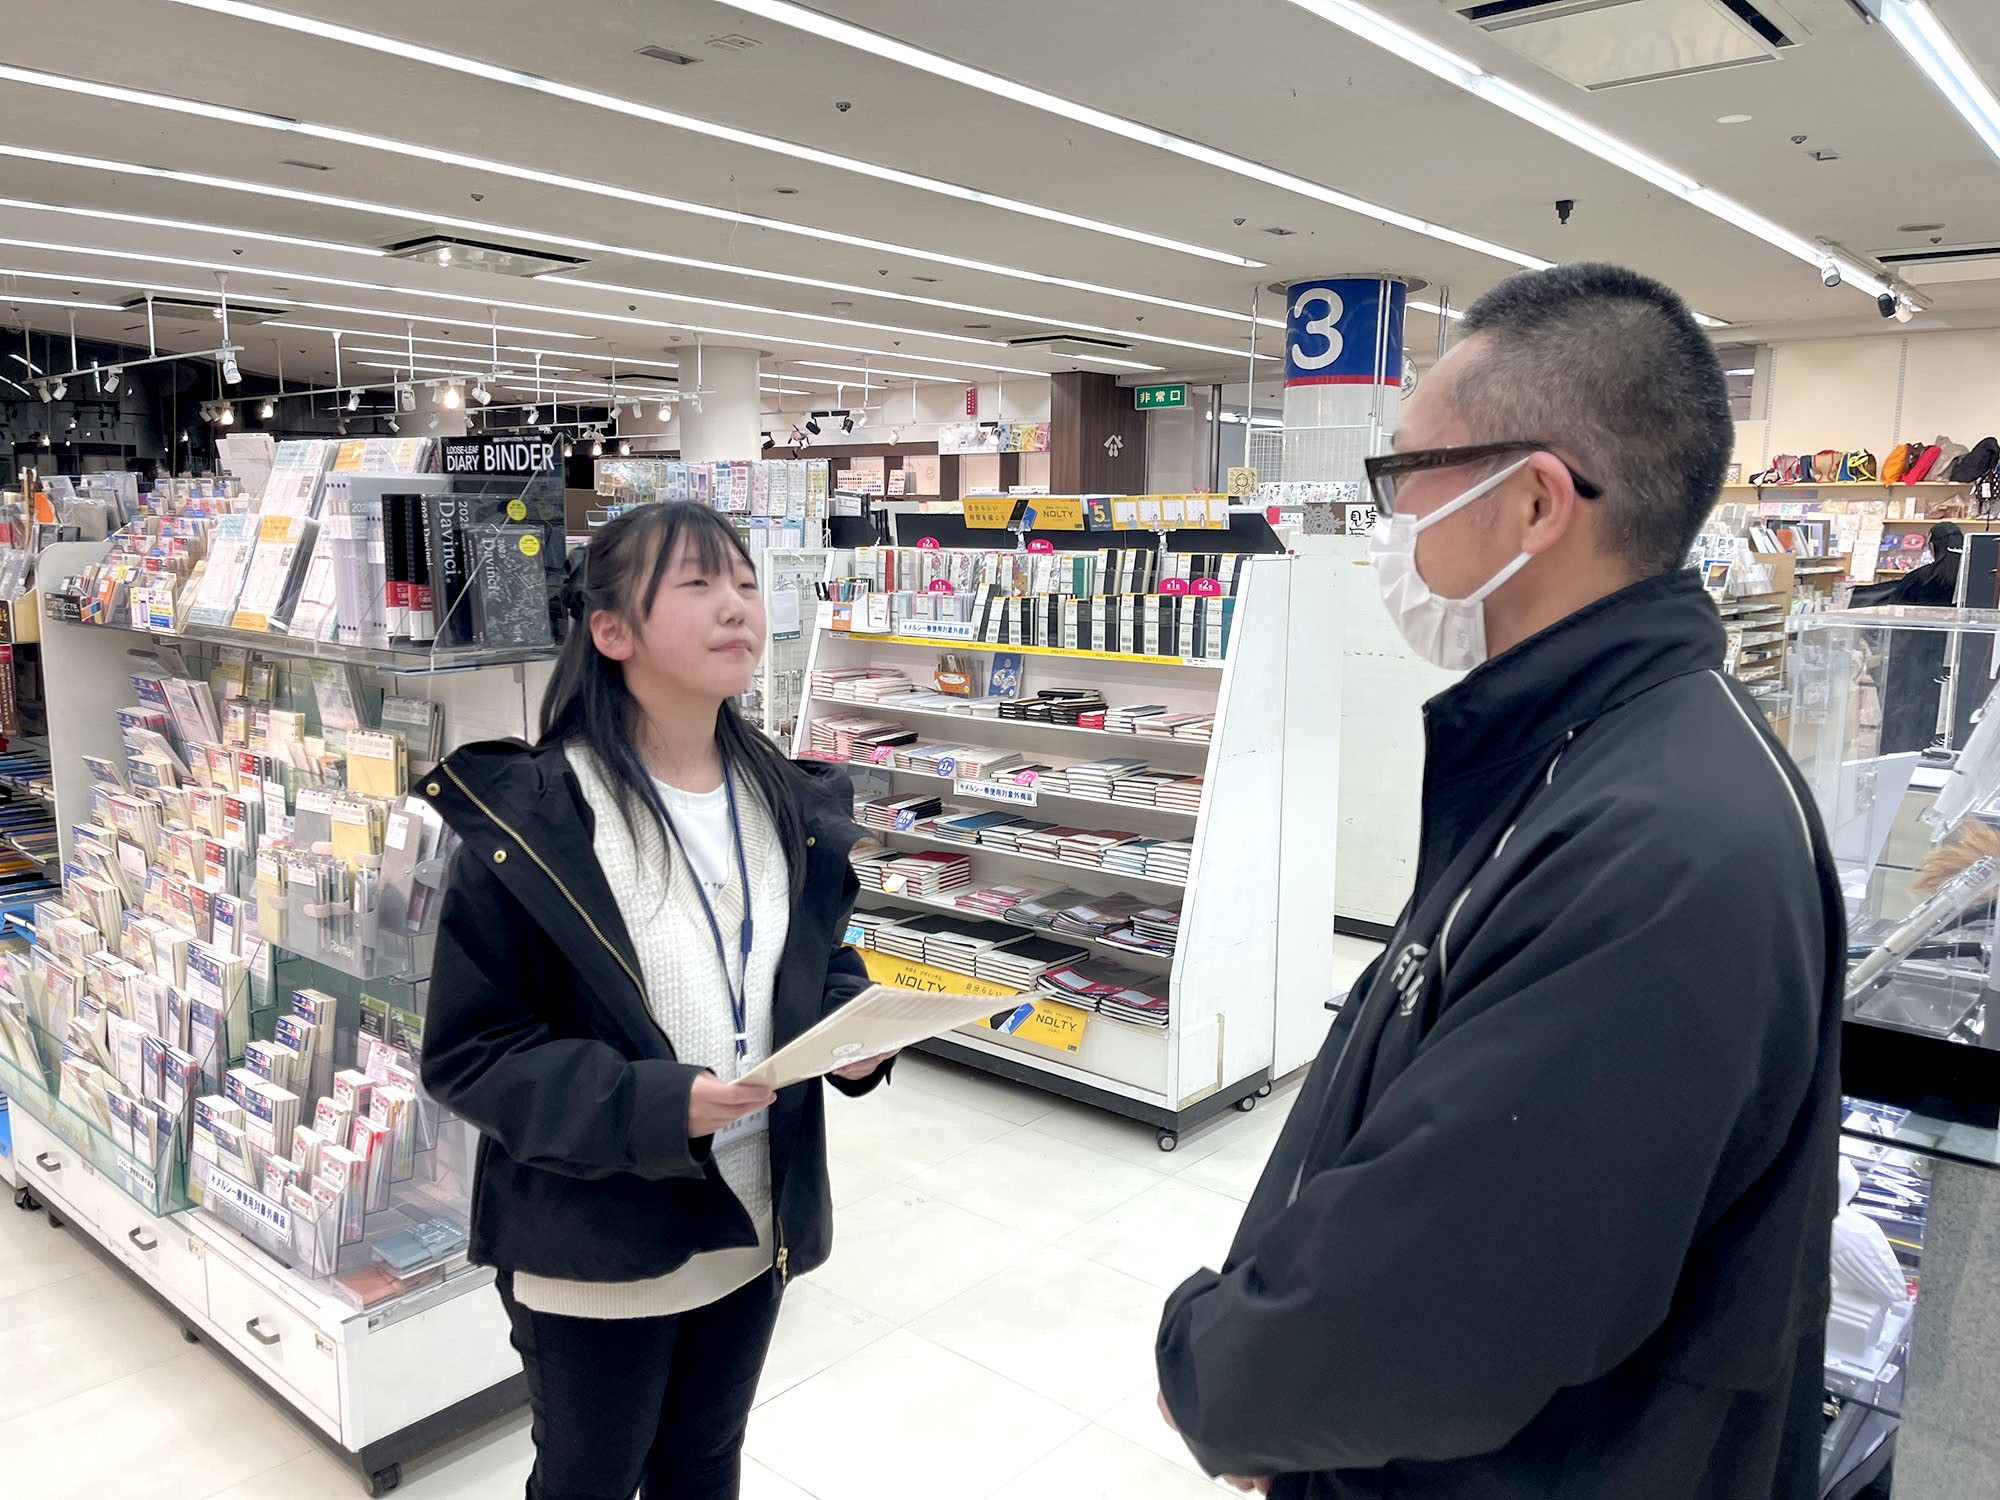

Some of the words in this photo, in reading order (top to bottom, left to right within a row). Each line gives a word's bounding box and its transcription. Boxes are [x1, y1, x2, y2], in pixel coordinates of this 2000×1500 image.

[1292, 288, 1344, 370] 3
[1140, 390, 1181, 403] 非常口
[446, 445, 480, 455] LOOSE-LEAF
[484, 443, 555, 471] BINDER
[447, 455, 480, 471] DIARY
[1043, 510, 1074, 518] NOLTY
[1094, 504, 1106, 522] 5
[894, 973, 947, 993] NOLTY
[1035, 1013, 1077, 1032] NOLTY
